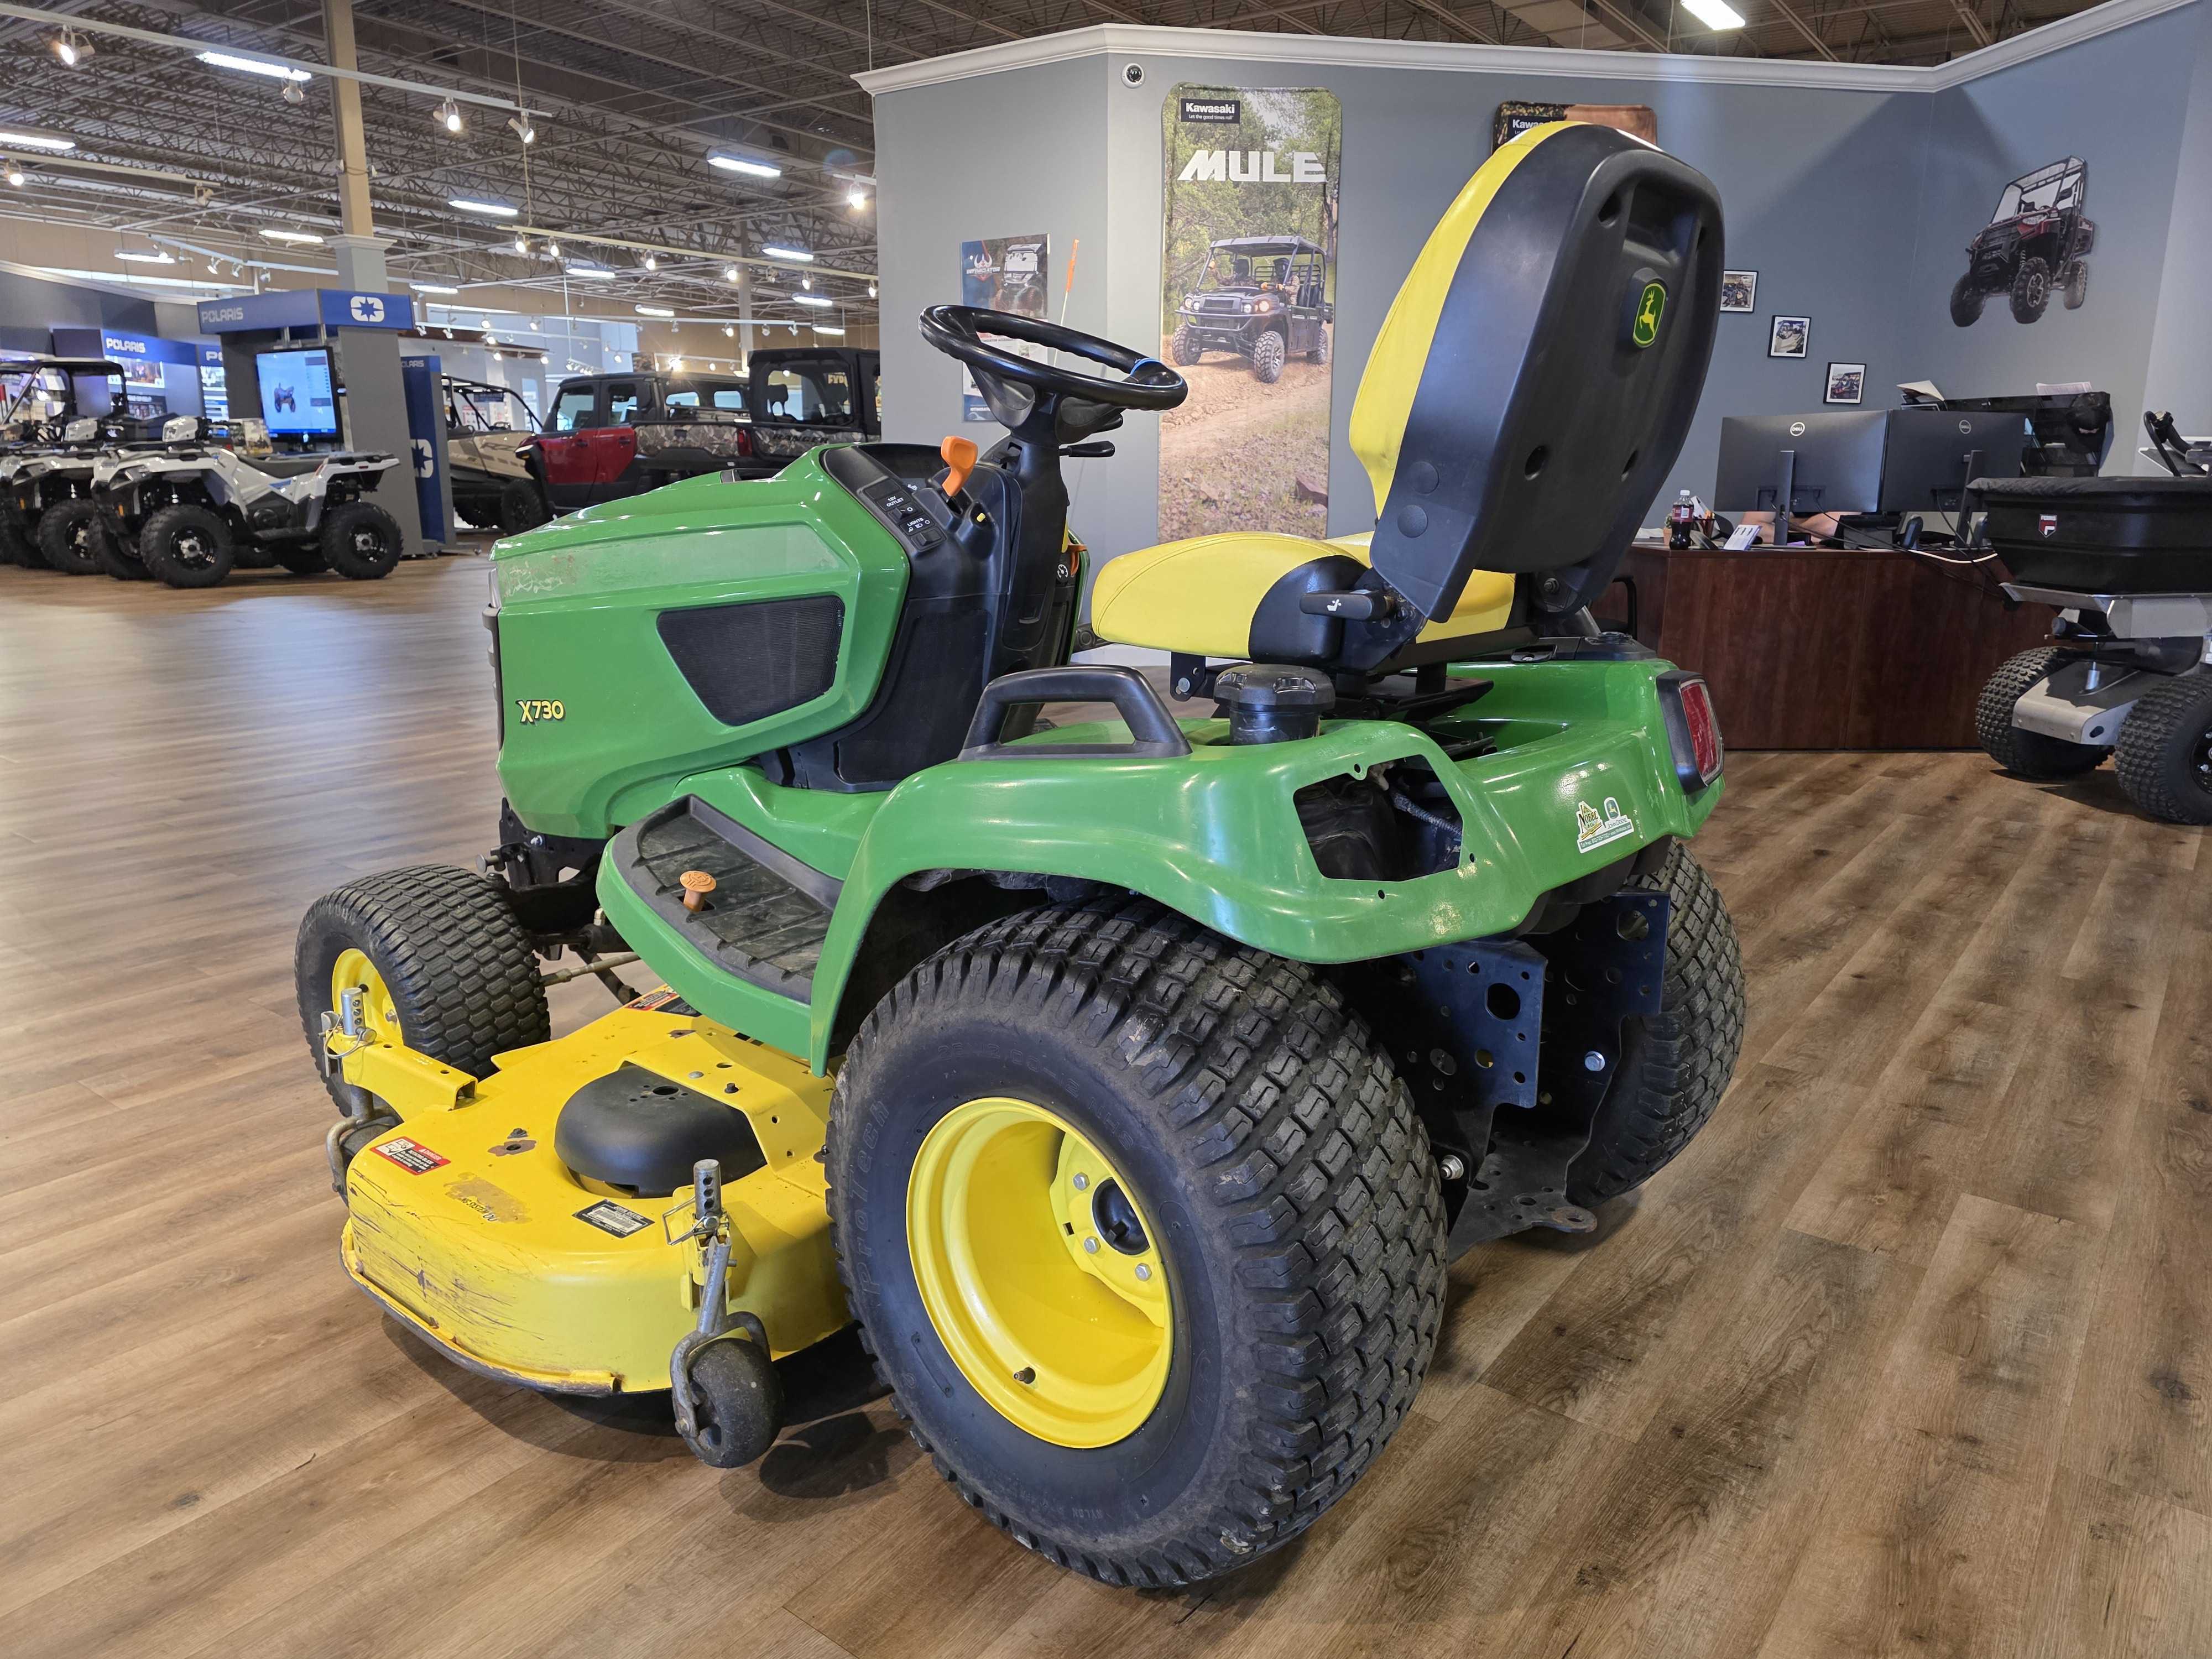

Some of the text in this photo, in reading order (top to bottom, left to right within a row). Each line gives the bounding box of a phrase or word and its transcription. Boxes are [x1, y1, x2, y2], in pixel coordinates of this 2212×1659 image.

[1186, 102, 1235, 113] Kawasaki
[1177, 150, 1328, 182] MULE
[201, 307, 243, 323] POLARIS
[106, 337, 145, 353] POLARIS
[401, 359, 425, 368] OLARIS
[774, 433, 829, 444] RANGER
[886, 497, 904, 507] OUTLET
[907, 518, 924, 527] LIGHTS
[515, 700, 565, 723] X730
[1578, 805, 1598, 834] NOBBE
[424, 1149, 442, 1161] DANGER
